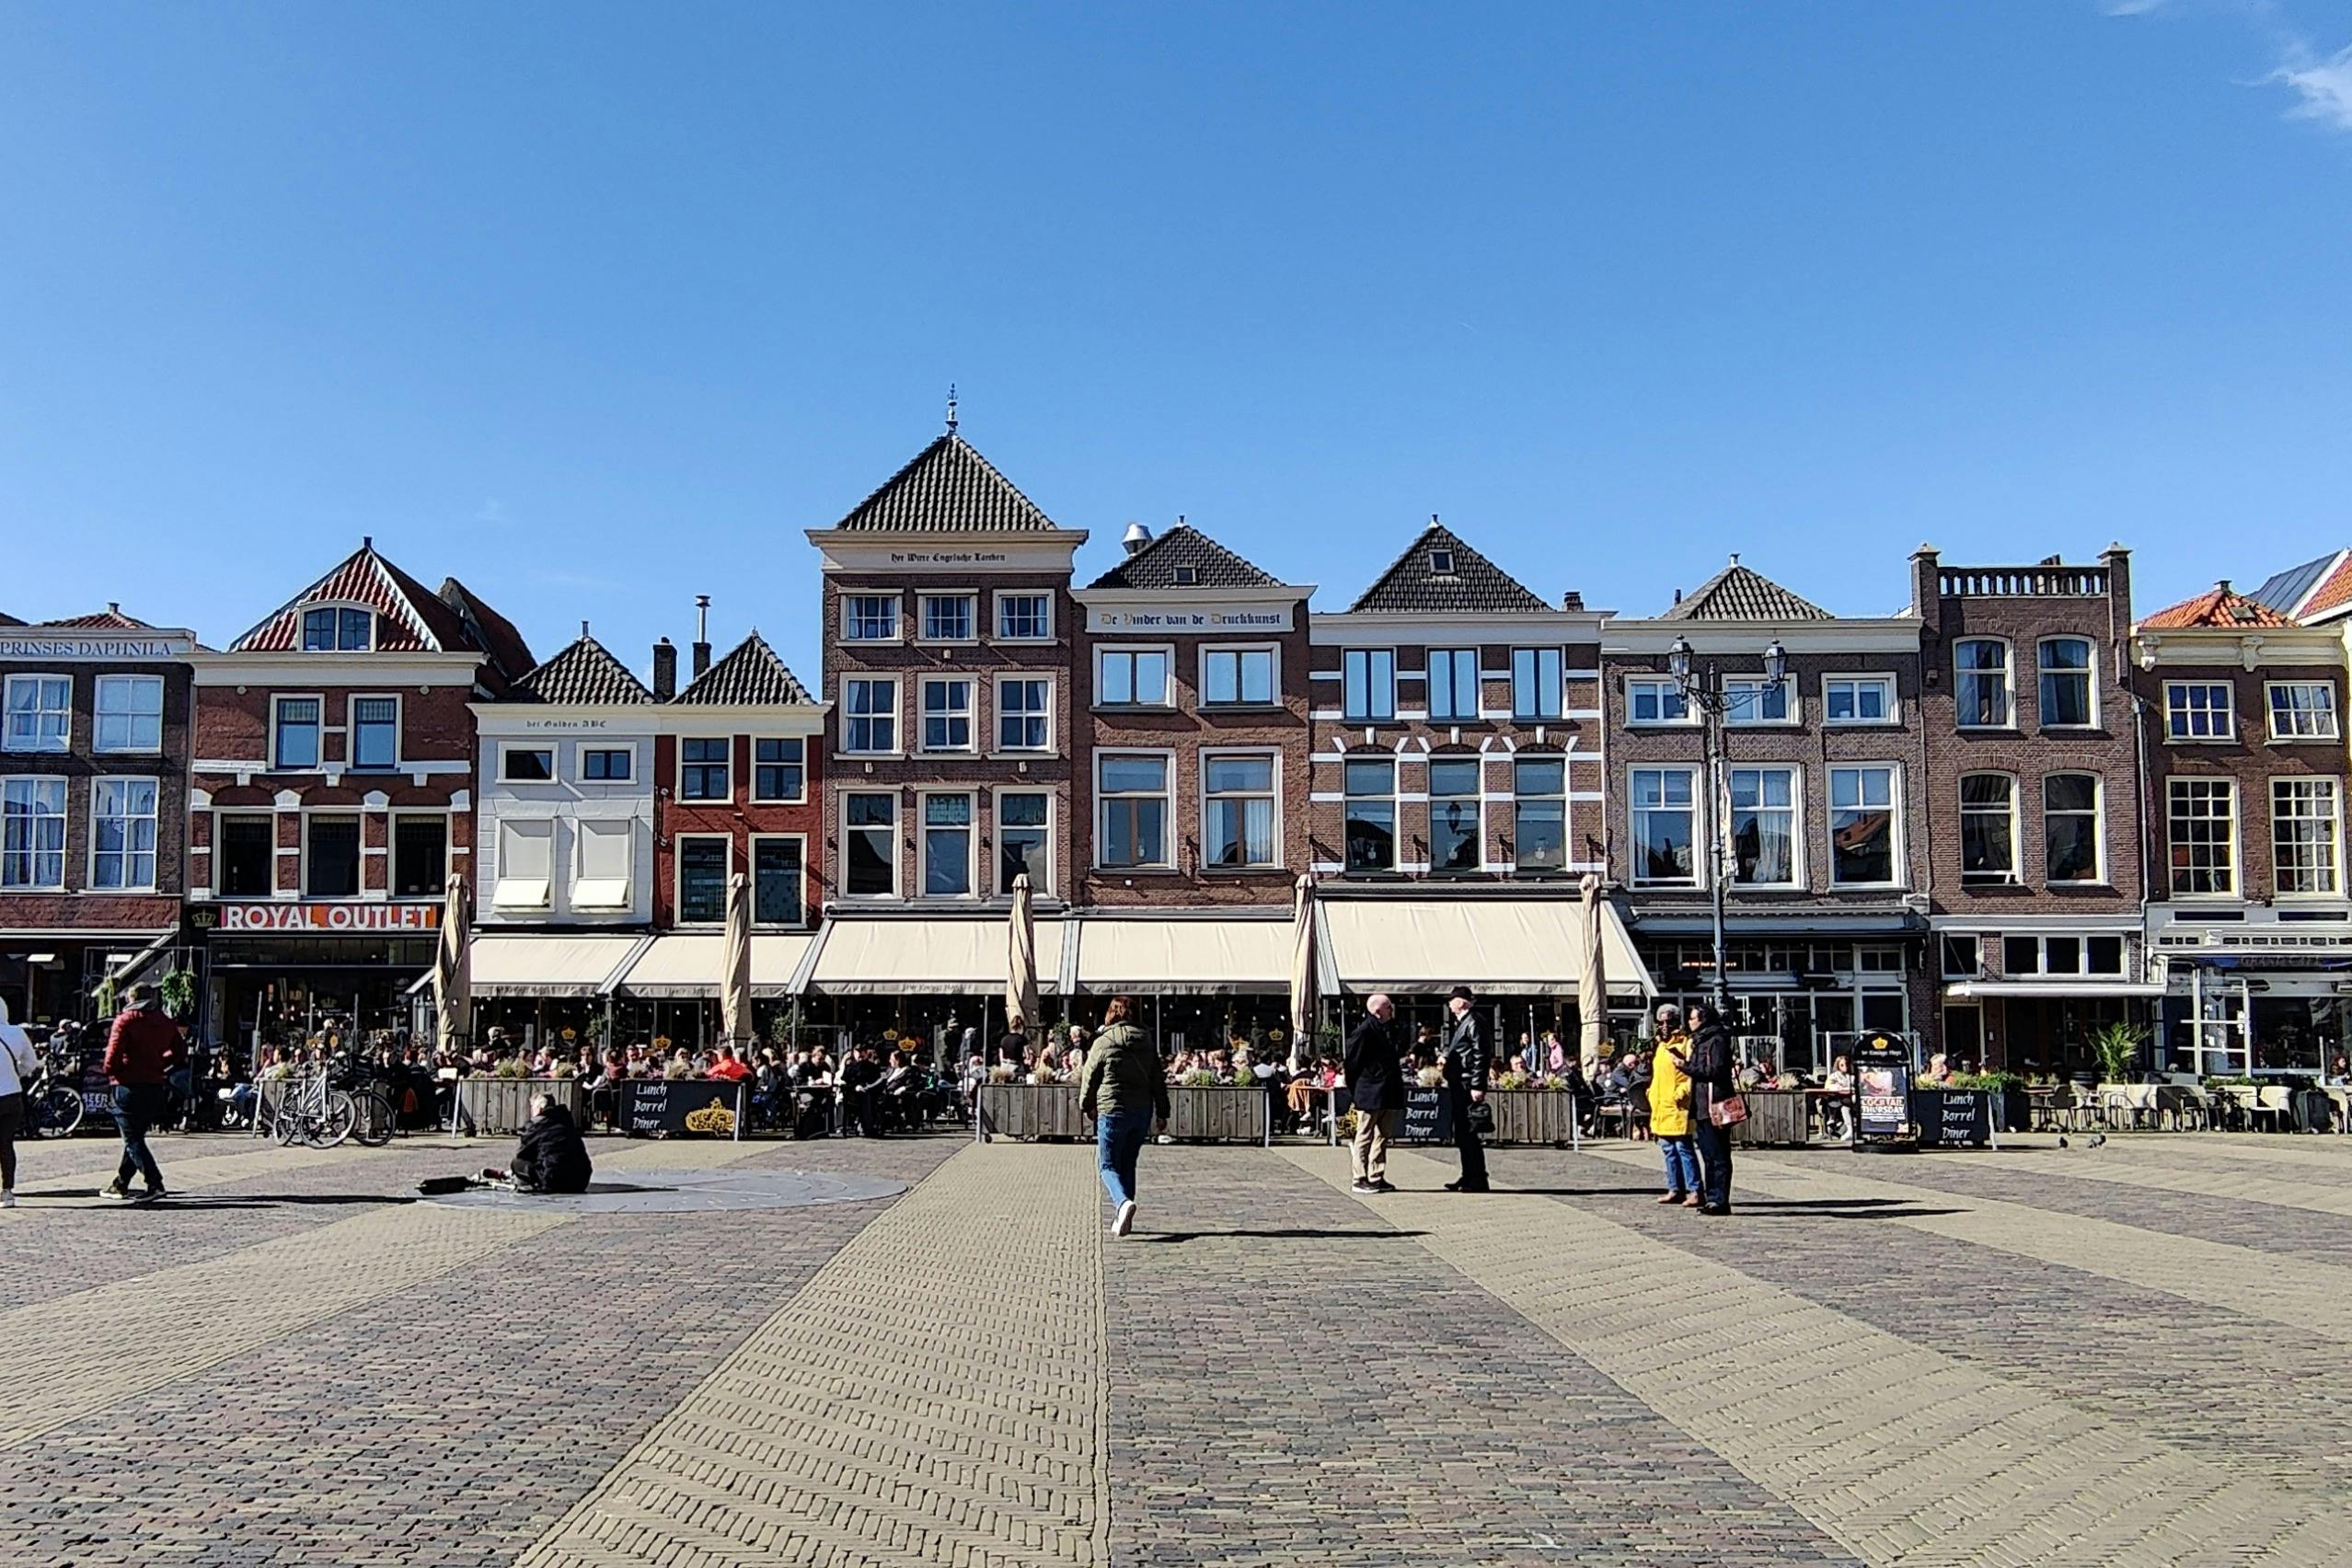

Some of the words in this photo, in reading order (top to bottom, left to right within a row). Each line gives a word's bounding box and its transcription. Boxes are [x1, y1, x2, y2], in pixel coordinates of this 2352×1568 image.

[1101, 613, 1117, 625] De
[1165, 615, 1186, 625] van
[1192, 614, 1204, 625] de
[1211, 613, 1280, 625] Druckkunst
[1, 641, 73, 655] PRINSES
[226, 905, 319, 929] ROYAL
[328, 905, 432, 929] OUTLET
[636, 1082, 667, 1096] Lunch
[1407, 1089, 1438, 1102] Lunch
[633, 1098, 667, 1112] Borrel
[1861, 1098, 1904, 1106] COCKTAIL
[1943, 1092, 1974, 1106] Lunch
[1405, 1105, 1439, 1119] Borrel
[1942, 1108, 1975, 1122] Borrel
[632, 1116, 661, 1129] Diner
[1405, 1124, 1433, 1136] Diner
[1942, 1125, 1970, 1138] Diner
